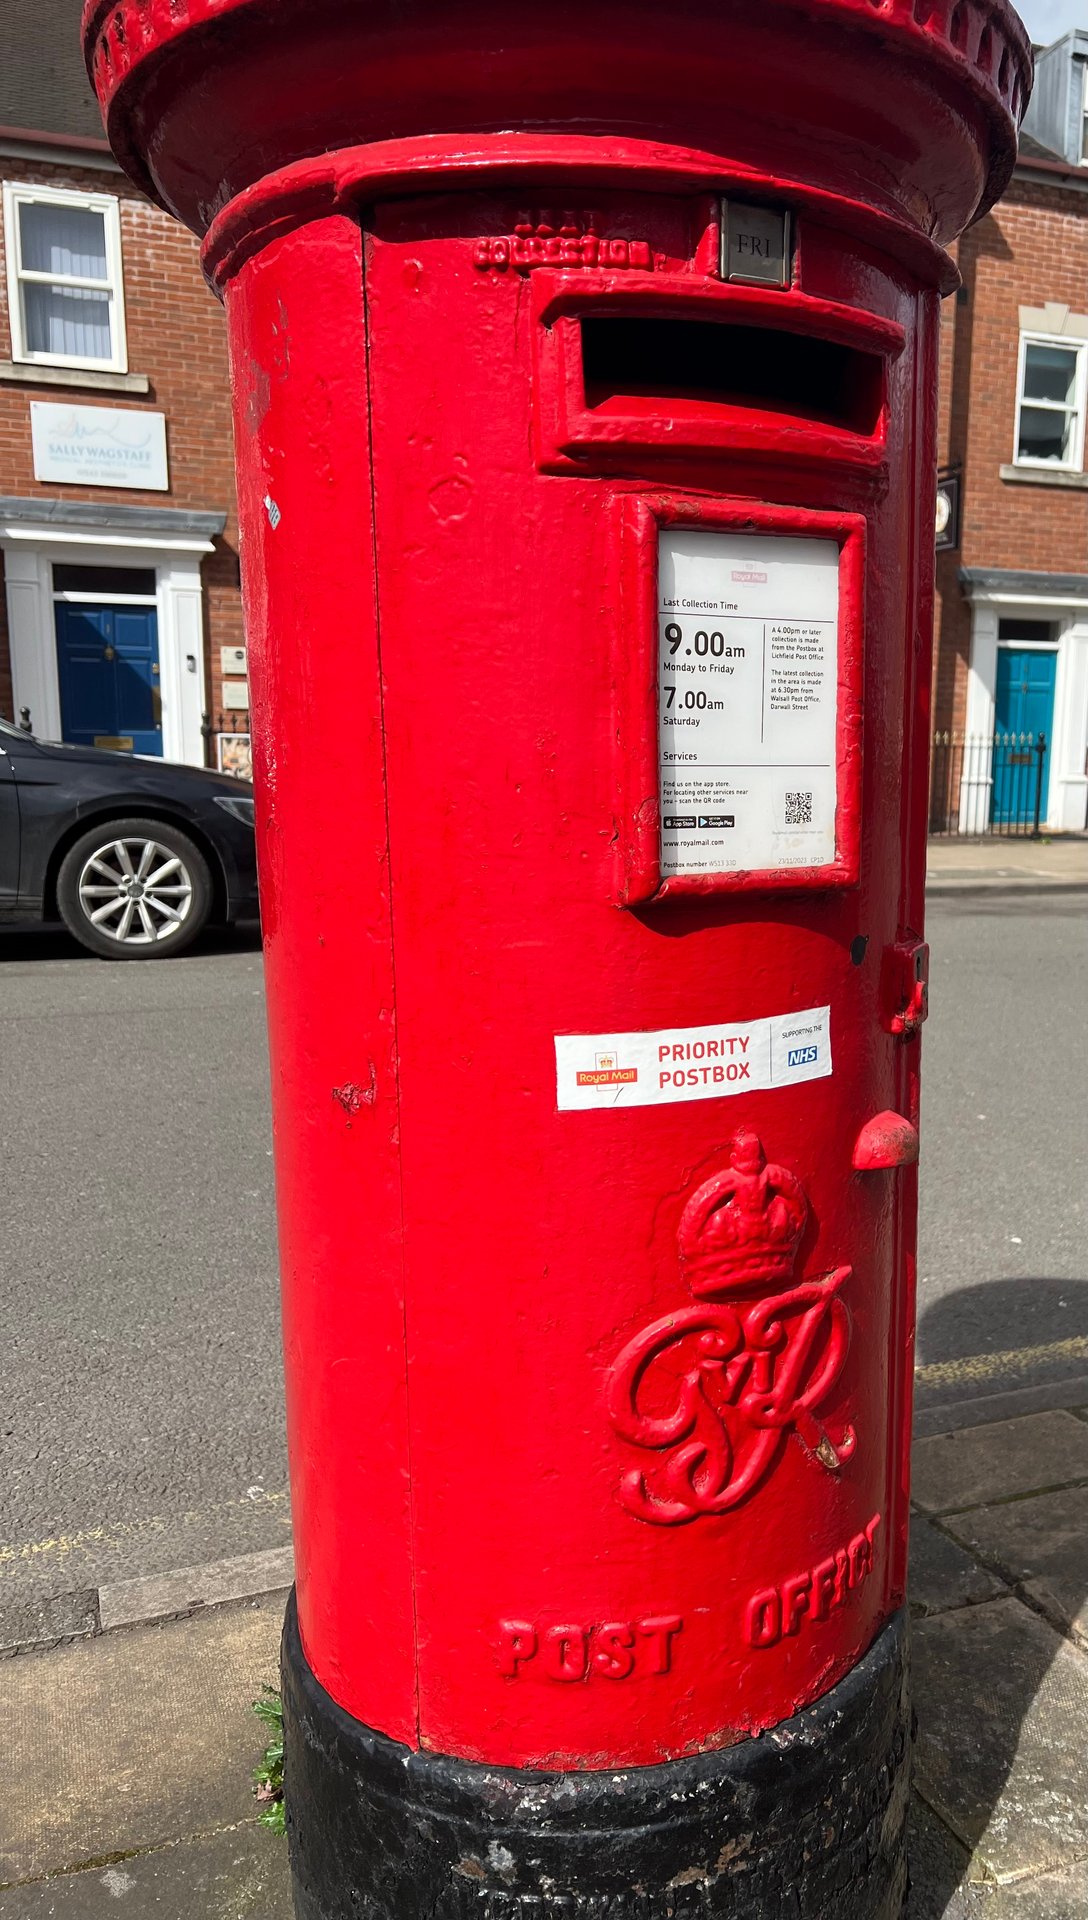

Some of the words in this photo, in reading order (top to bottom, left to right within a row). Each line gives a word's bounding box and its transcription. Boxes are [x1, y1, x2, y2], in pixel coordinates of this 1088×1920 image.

[735, 233, 771, 258] FRI
[48, 443, 84, 457] SALLY
[85, 446, 152, 462] WAGSTAFF
[663, 597, 680, 607] Last
[682, 599, 718, 609] Collection
[720, 601, 739, 611] Time
[809, 628, 822, 636] later
[664, 622, 746, 658] 9.00am
[796, 645, 817, 653] Postbox
[771, 652, 795, 660] Lichfield
[808, 653, 824, 661] Office
[663, 662, 696, 674] Monday
[698, 664, 707, 672] to
[709, 664, 735, 676] Friday
[663, 686, 725, 710] 7.00am
[663, 716, 701, 728] Saturday
[663, 751, 698, 761] Services
[674, 789, 696, 797] locating
[724, 819, 733, 827] Play
[663, 838, 725, 848] www.royalmail.com
[781, 1026, 813, 1039] SUPPORTING
[813, 1024, 823, 1032] THE
[658, 1035, 750, 1063] PRIORITY
[790, 1046, 816, 1066] NHS
[579, 1071, 607, 1084] Royal
[611, 1070, 635, 1081] Mail
[659, 1061, 751, 1089] POSTBOX
[500, 1614, 683, 1682] POST
